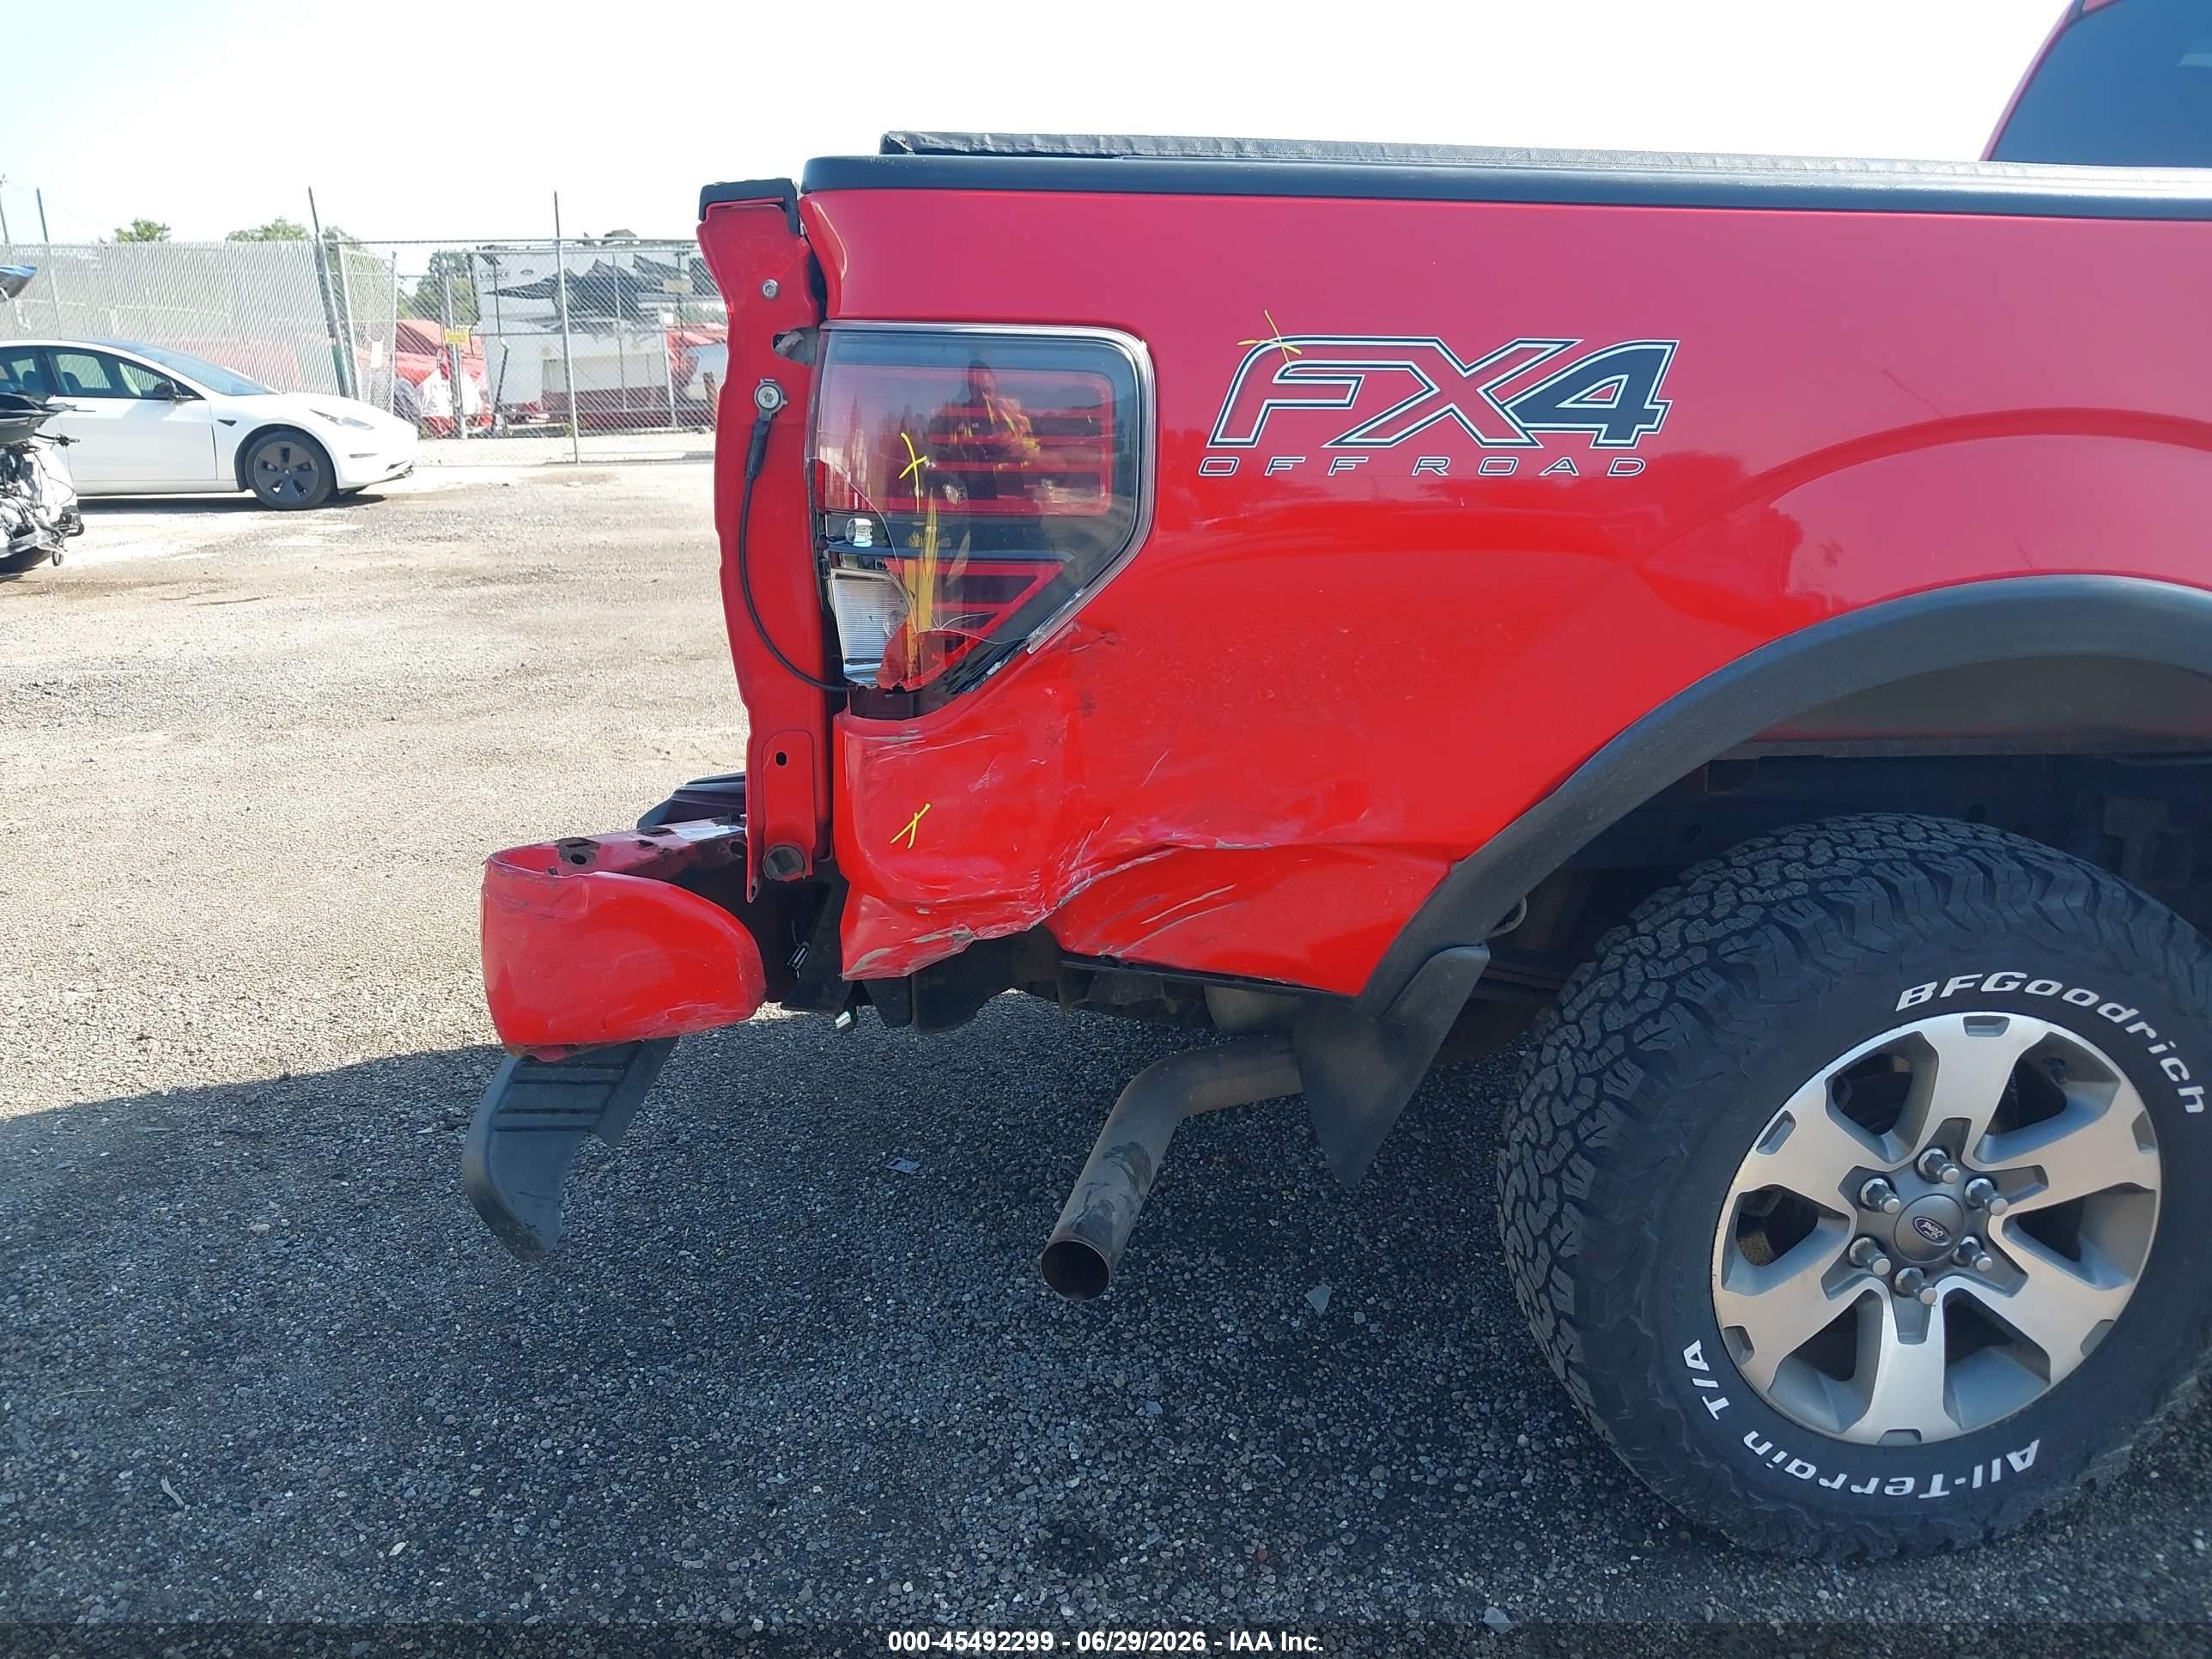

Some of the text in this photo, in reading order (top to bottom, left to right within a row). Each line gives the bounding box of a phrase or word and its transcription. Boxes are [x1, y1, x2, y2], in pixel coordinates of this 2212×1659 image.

[1206, 334, 1680, 448] FX4
[1198, 456, 1646, 477] OFF ROAD
[1895, 971, 2205, 1115] BFGoodrich
[1921, 1221, 1944, 1239] Ford
[1682, 1338, 2041, 1500] All-Terrain T/A
